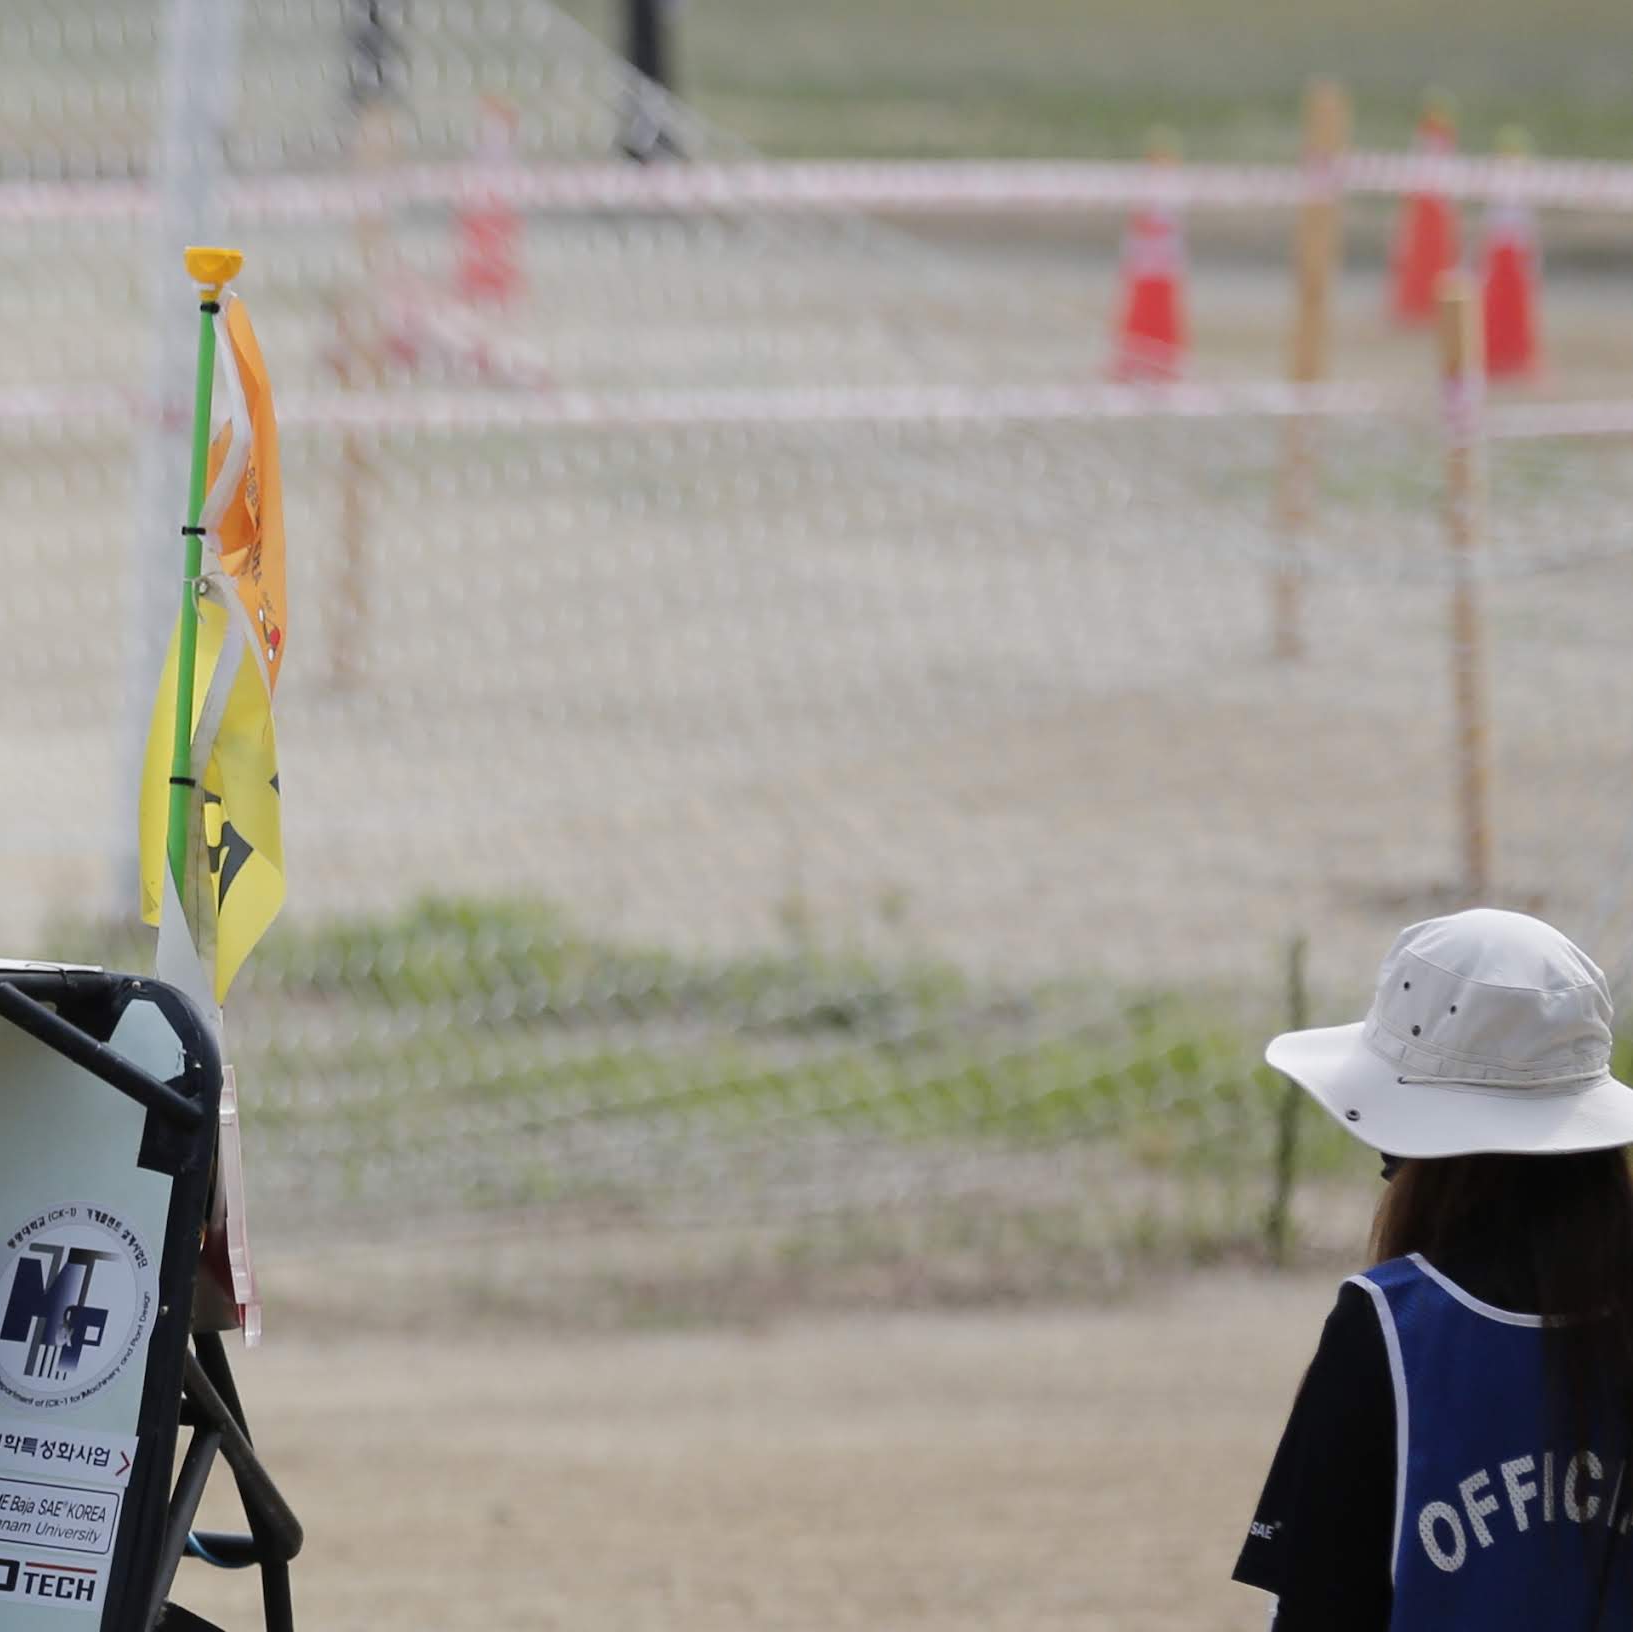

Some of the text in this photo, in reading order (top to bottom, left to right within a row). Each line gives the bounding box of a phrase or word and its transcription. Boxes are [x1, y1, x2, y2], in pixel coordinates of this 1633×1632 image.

[9, 1494, 36, 1517] Baja
[66, 1502, 107, 1523] KOREA
[34, 1521, 103, 1545] University
